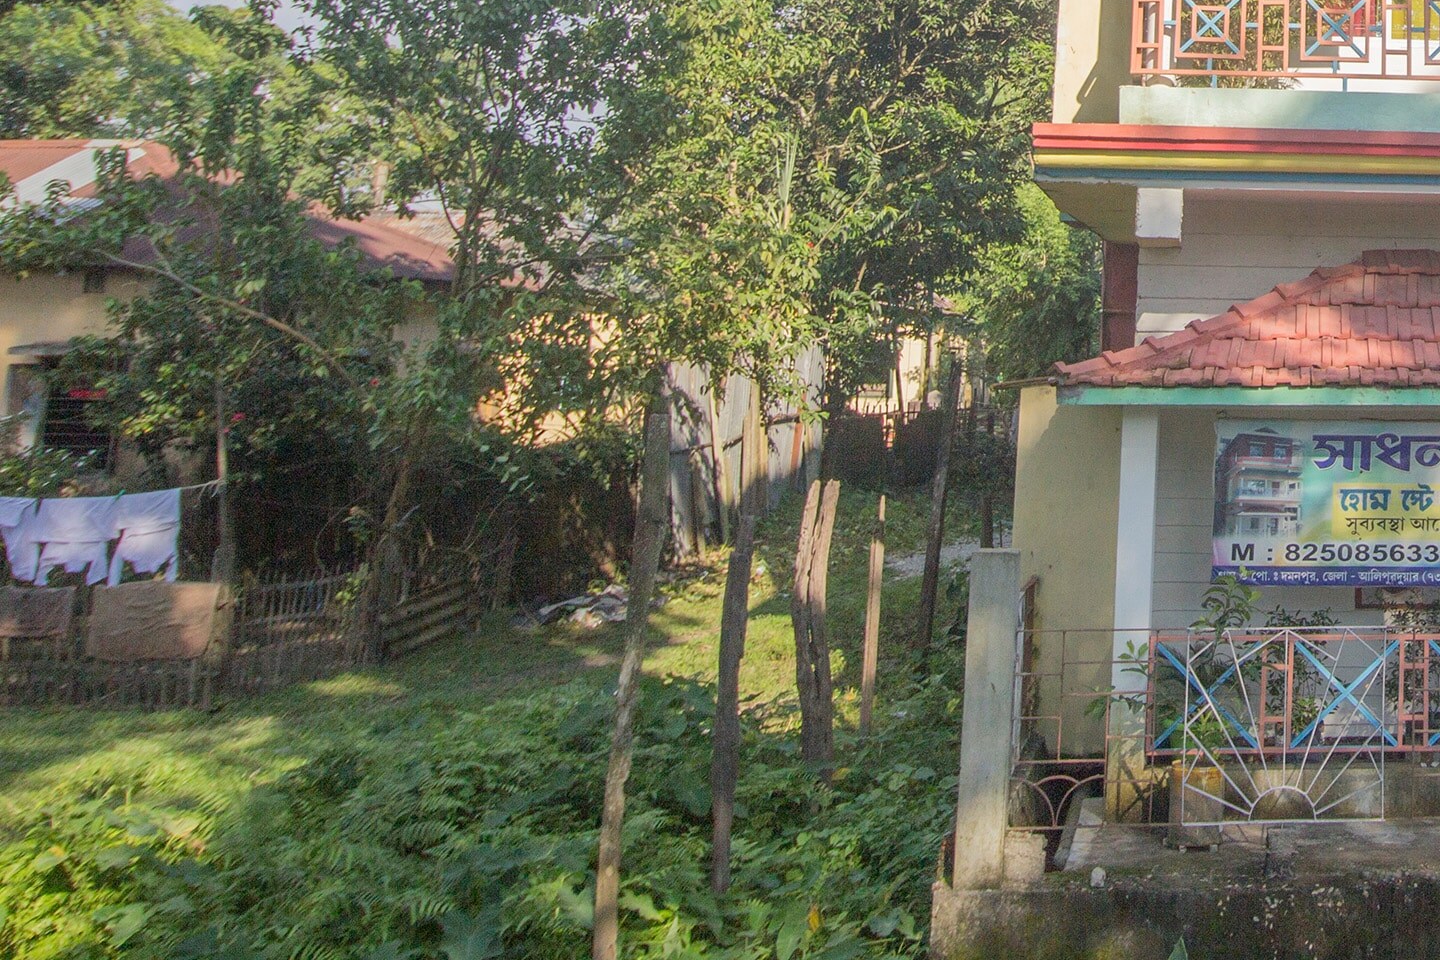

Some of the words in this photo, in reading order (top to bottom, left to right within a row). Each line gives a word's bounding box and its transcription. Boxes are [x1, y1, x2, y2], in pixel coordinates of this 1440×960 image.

[1339, 488, 1392, 512] হোম
[1401, 483, 1435, 512] স্টে
[1346, 517, 1405, 537] সুব্যবস্থা
[1231, 543, 1255, 561] M
[1280, 571, 1319, 585] দমনপুর,
[1322, 570, 1348, 582] জেলা
